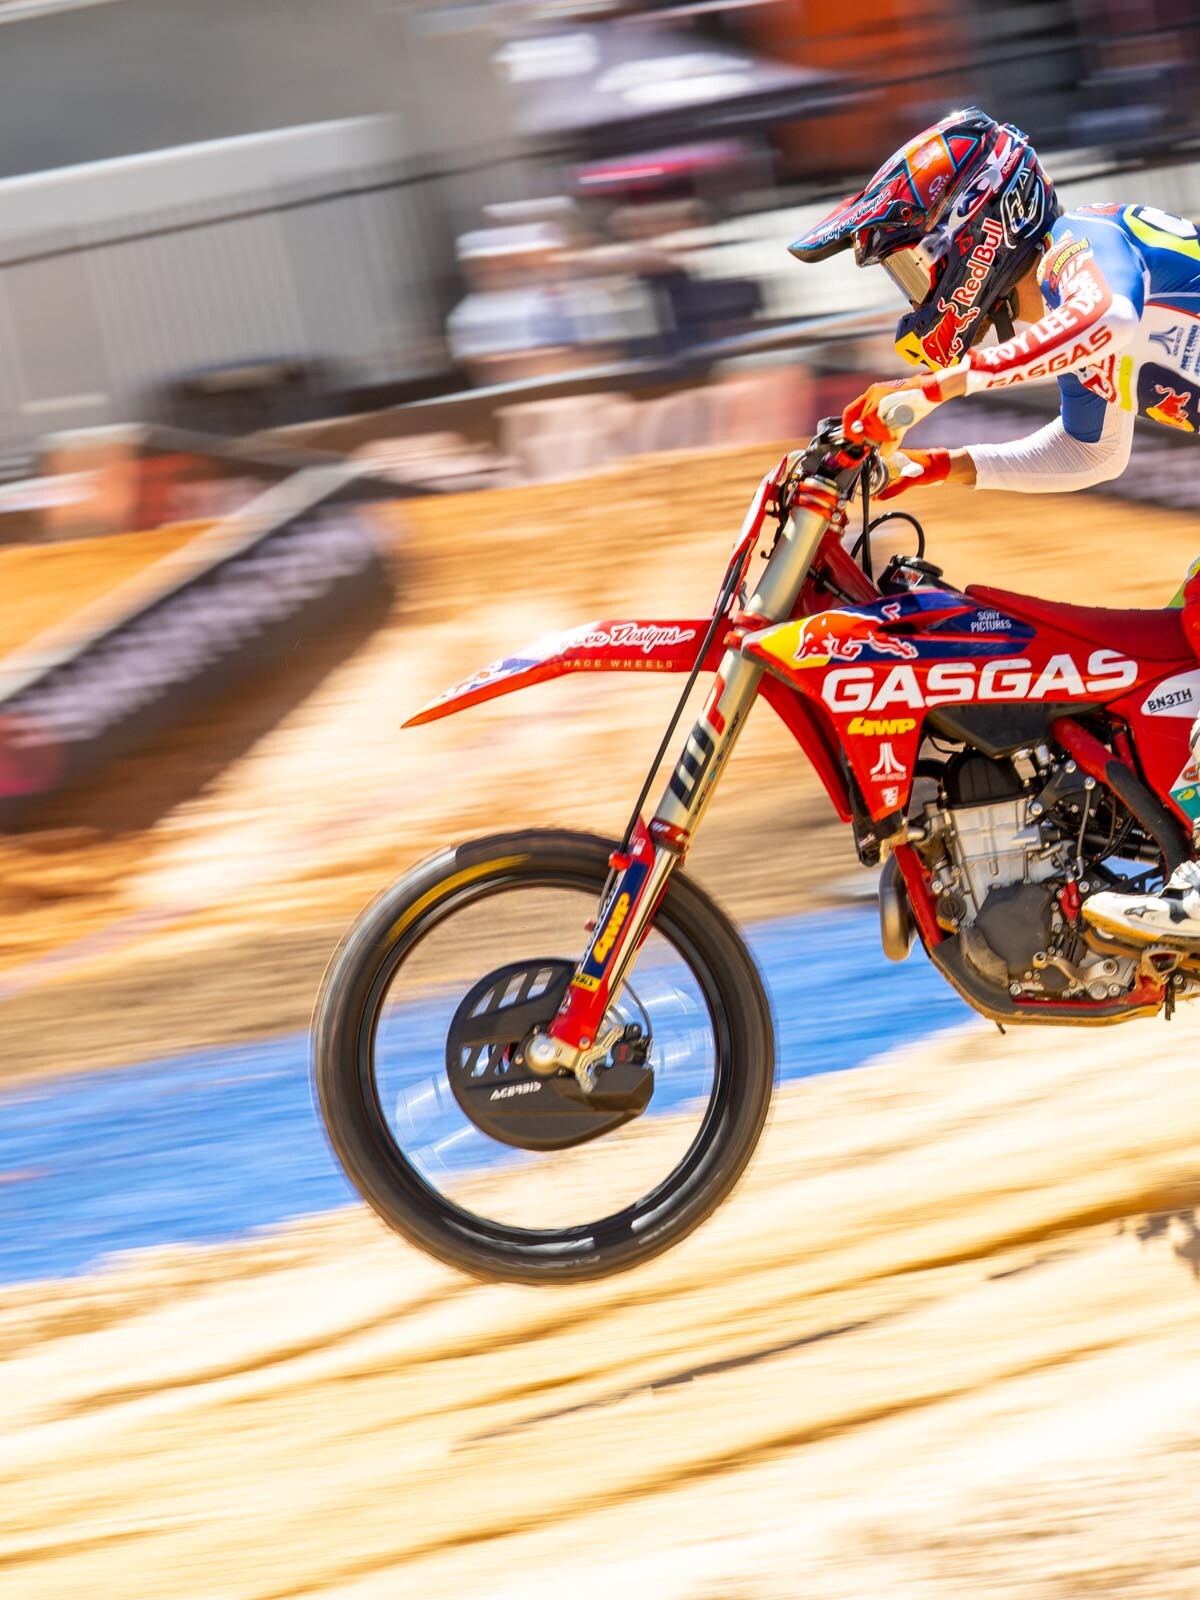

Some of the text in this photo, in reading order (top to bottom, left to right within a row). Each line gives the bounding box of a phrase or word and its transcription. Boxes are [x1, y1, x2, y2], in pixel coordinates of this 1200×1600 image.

[953, 218, 1003, 307] Red Bull
[1030, 308, 1079, 344] LEE
[971, 619, 1012, 632] PICTURES
[977, 610, 1000, 620] SONY
[611, 623, 695, 653] Designs
[822, 649, 1138, 712] GASGAS
[1147, 688, 1193, 711] BN3TH
